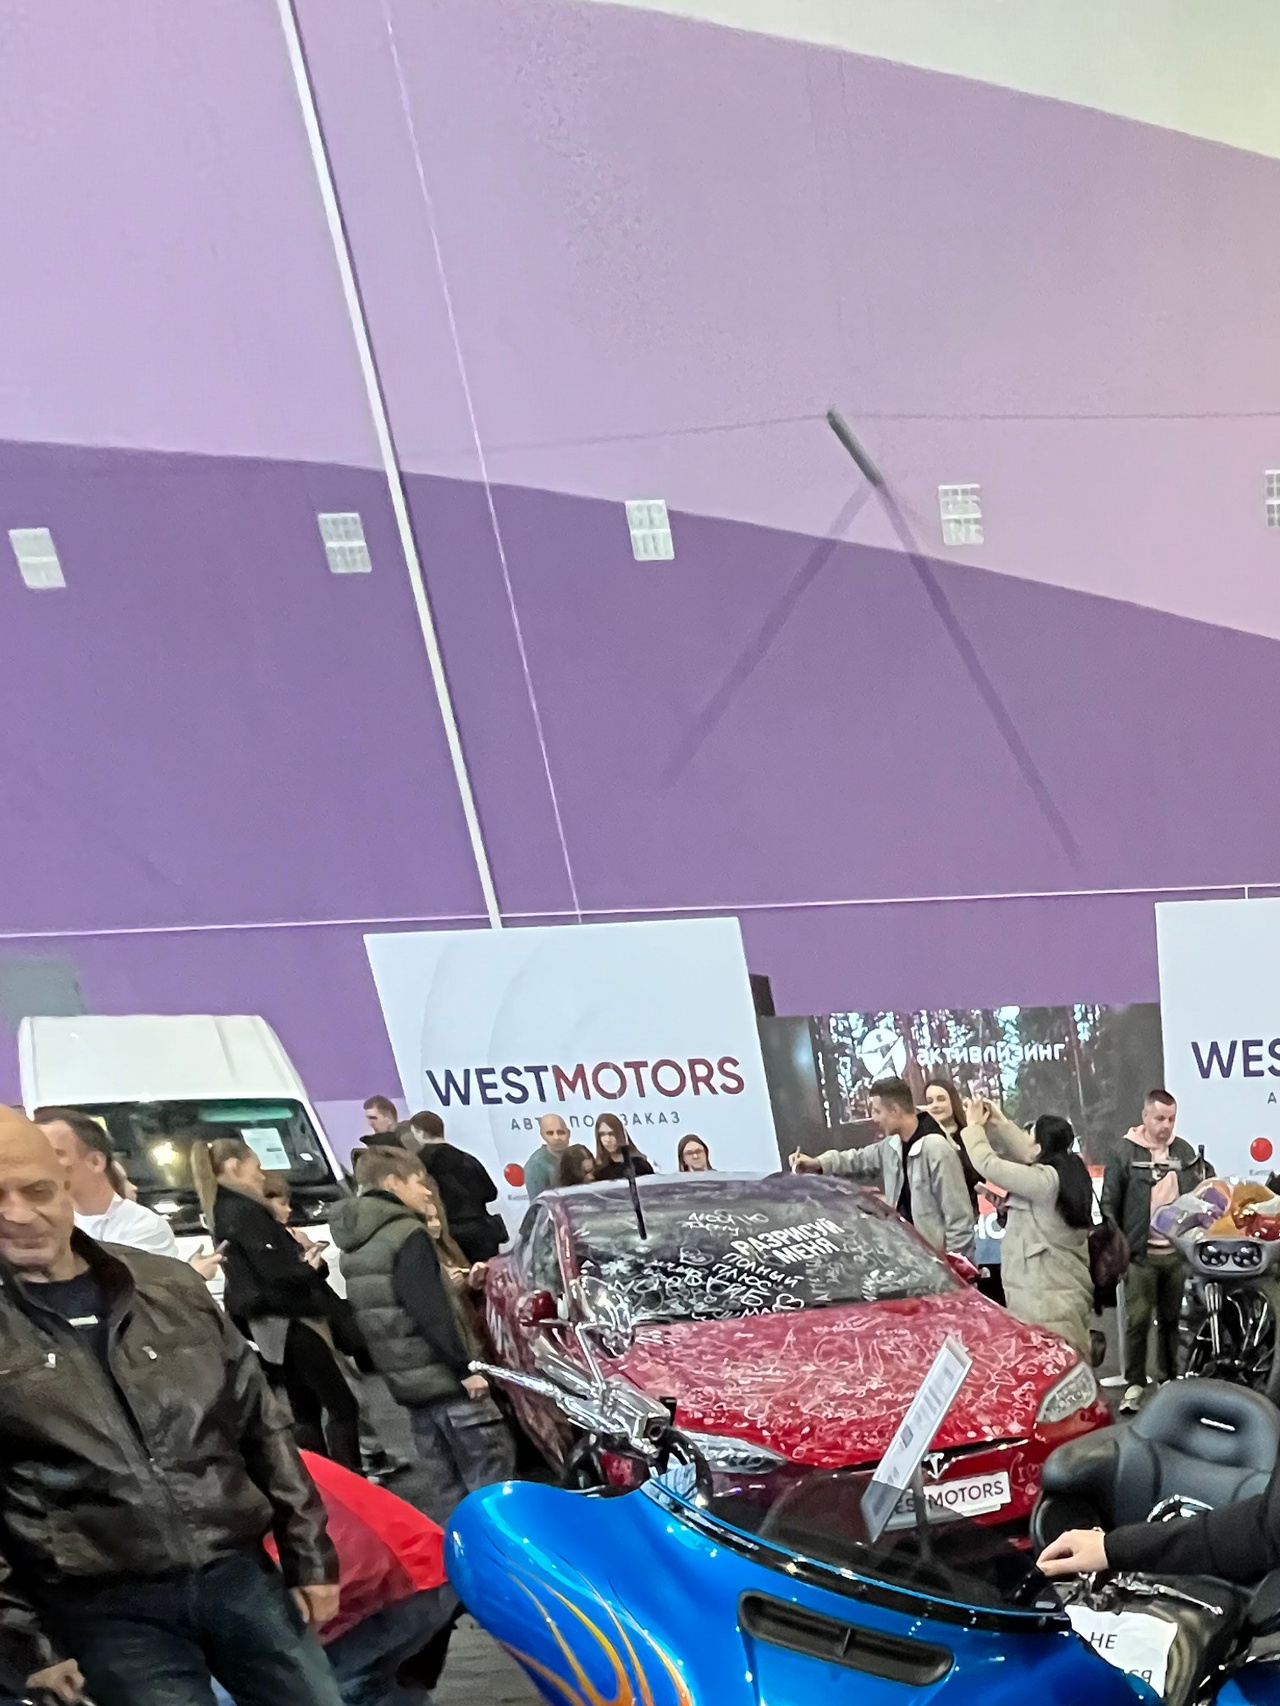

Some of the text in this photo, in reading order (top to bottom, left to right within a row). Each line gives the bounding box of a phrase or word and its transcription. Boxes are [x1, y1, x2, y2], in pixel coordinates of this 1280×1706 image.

[426, 1056, 746, 1106] WESTMOTORS
[569, 1115, 595, 1128] ПО
[730, 1217, 845, 1256] РАЗРИСУЙ
[771, 1237, 841, 1265] МЕНЯ
